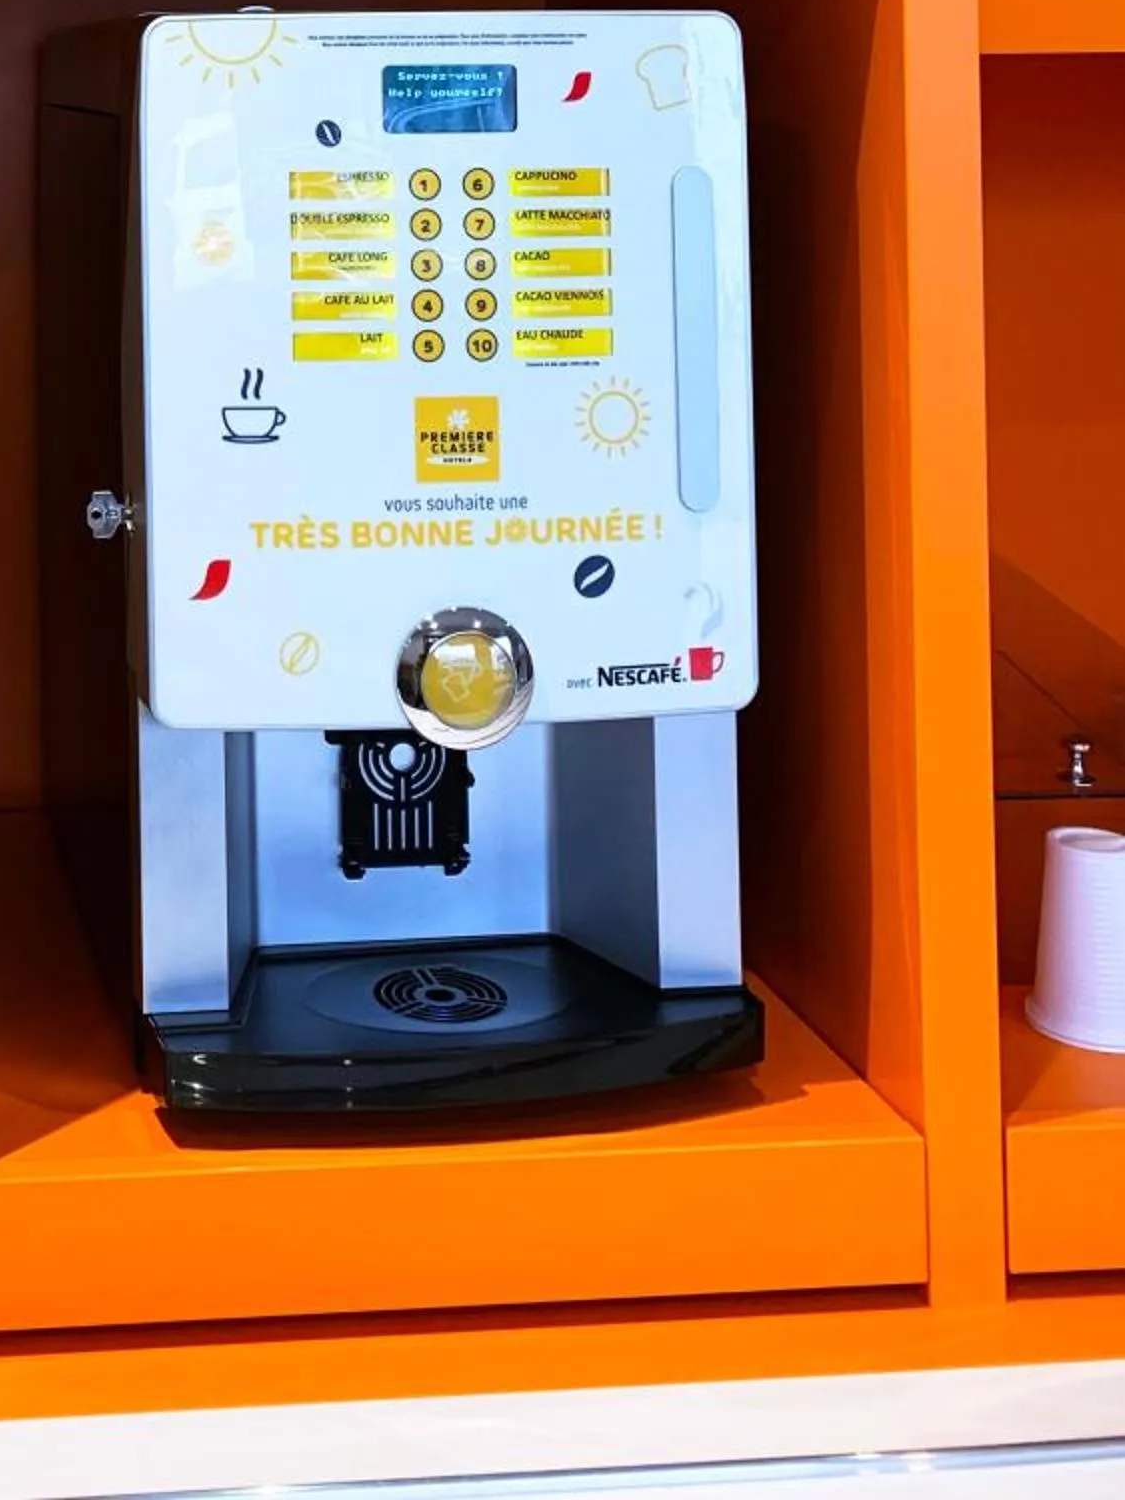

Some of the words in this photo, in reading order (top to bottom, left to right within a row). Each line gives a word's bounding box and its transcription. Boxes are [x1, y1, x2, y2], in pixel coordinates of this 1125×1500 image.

[397, 71, 488, 82] Servez-vous
[388, 87, 423, 98] Help
[337, 171, 390, 182] ESPRESSO
[515, 171, 577, 181] CAPPUCINO
[473, 178, 483, 191] 6
[337, 211, 390, 224] ESPRESSO
[515, 209, 547, 220] LATTE
[549, 208, 611, 221] MACCHIATO
[421, 219, 431, 233] 2
[475, 219, 485, 232] 7
[328, 252, 355, 262] CAFE
[357, 251, 388, 262] LONG
[515, 250, 550, 261] CACAO
[421, 260, 431, 273] 3
[475, 259, 486, 272] 8
[324, 295, 351, 304] CAFE
[353, 294, 369, 304] AU
[372, 294, 395, 304] LAIT
[515, 291, 552, 302] CACAO
[554, 289, 604, 301] VIENNOIS
[423, 299, 433, 312] 4
[476, 299, 487, 312] 9
[359, 332, 383, 342] LAIT
[516, 330, 537, 340] EAU
[539, 328, 584, 340] CHAUDE
[423, 340, 433, 352] 5
[473, 340, 492, 352] 10
[431, 443, 486, 454] CLASSE
[384, 497, 422, 512] vous
[425, 494, 495, 512] souhaite
[499, 496, 528, 510] une
[249, 514, 341, 549] TRÈS
[351, 519, 473, 548] BONNE
[485, 508, 644, 546] JOURNÉE
[654, 514, 663, 539] !
[567, 678, 592, 688] avec
[597, 656, 683, 688] NESCAFÉ
